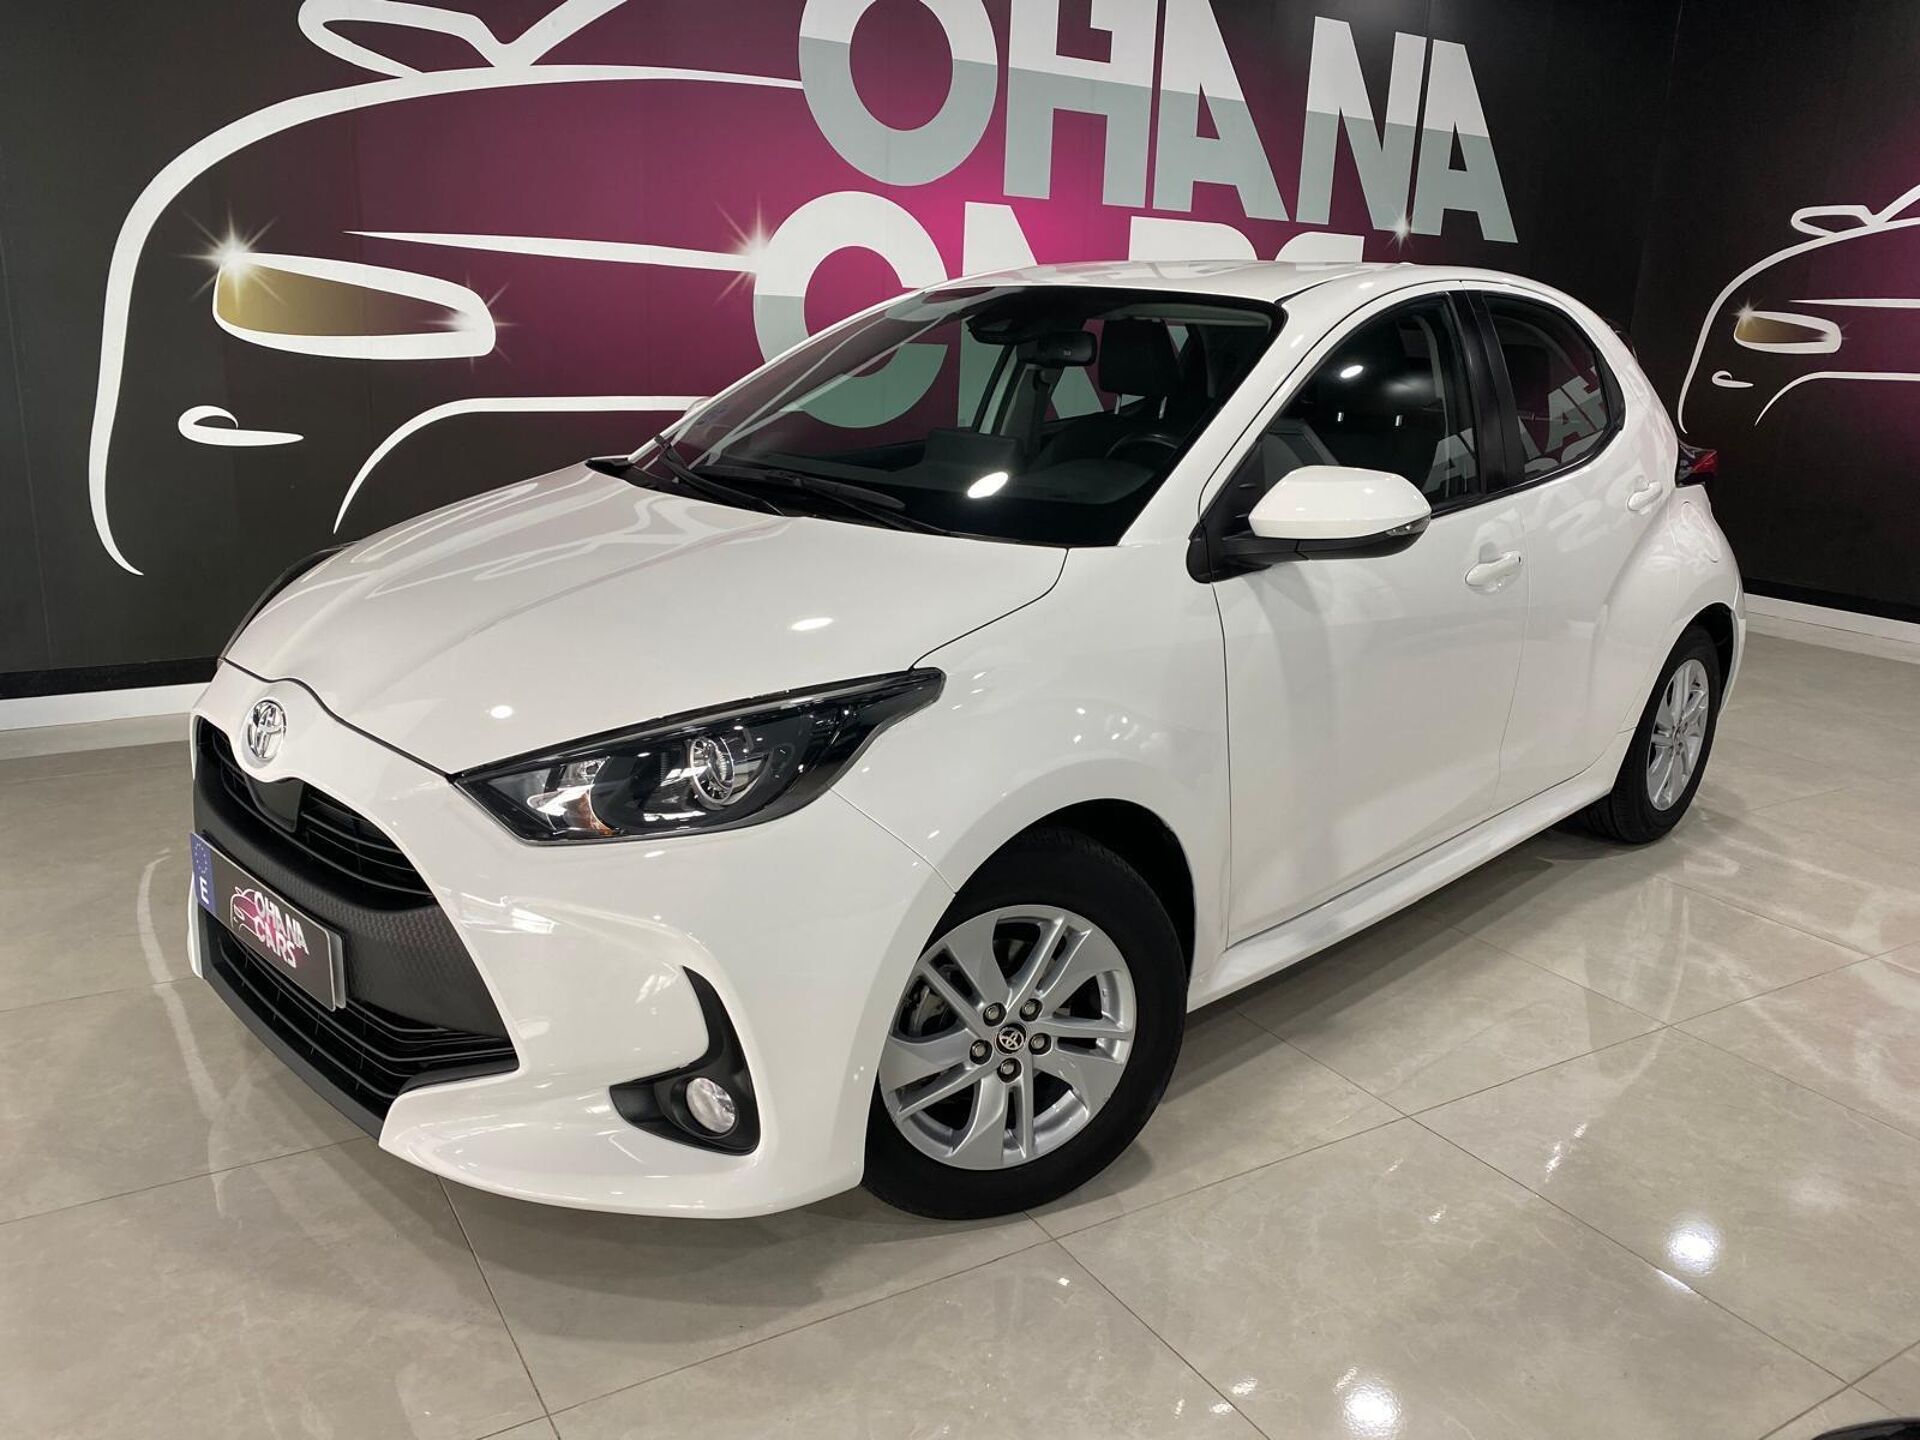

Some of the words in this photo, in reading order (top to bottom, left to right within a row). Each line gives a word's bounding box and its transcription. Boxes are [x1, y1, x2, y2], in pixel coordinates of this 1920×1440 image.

[798, 0, 1519, 244] OHANA
[199, 875, 210, 905] E
[254, 891, 310, 956] OHANA
[254, 915, 297, 969] CARS
